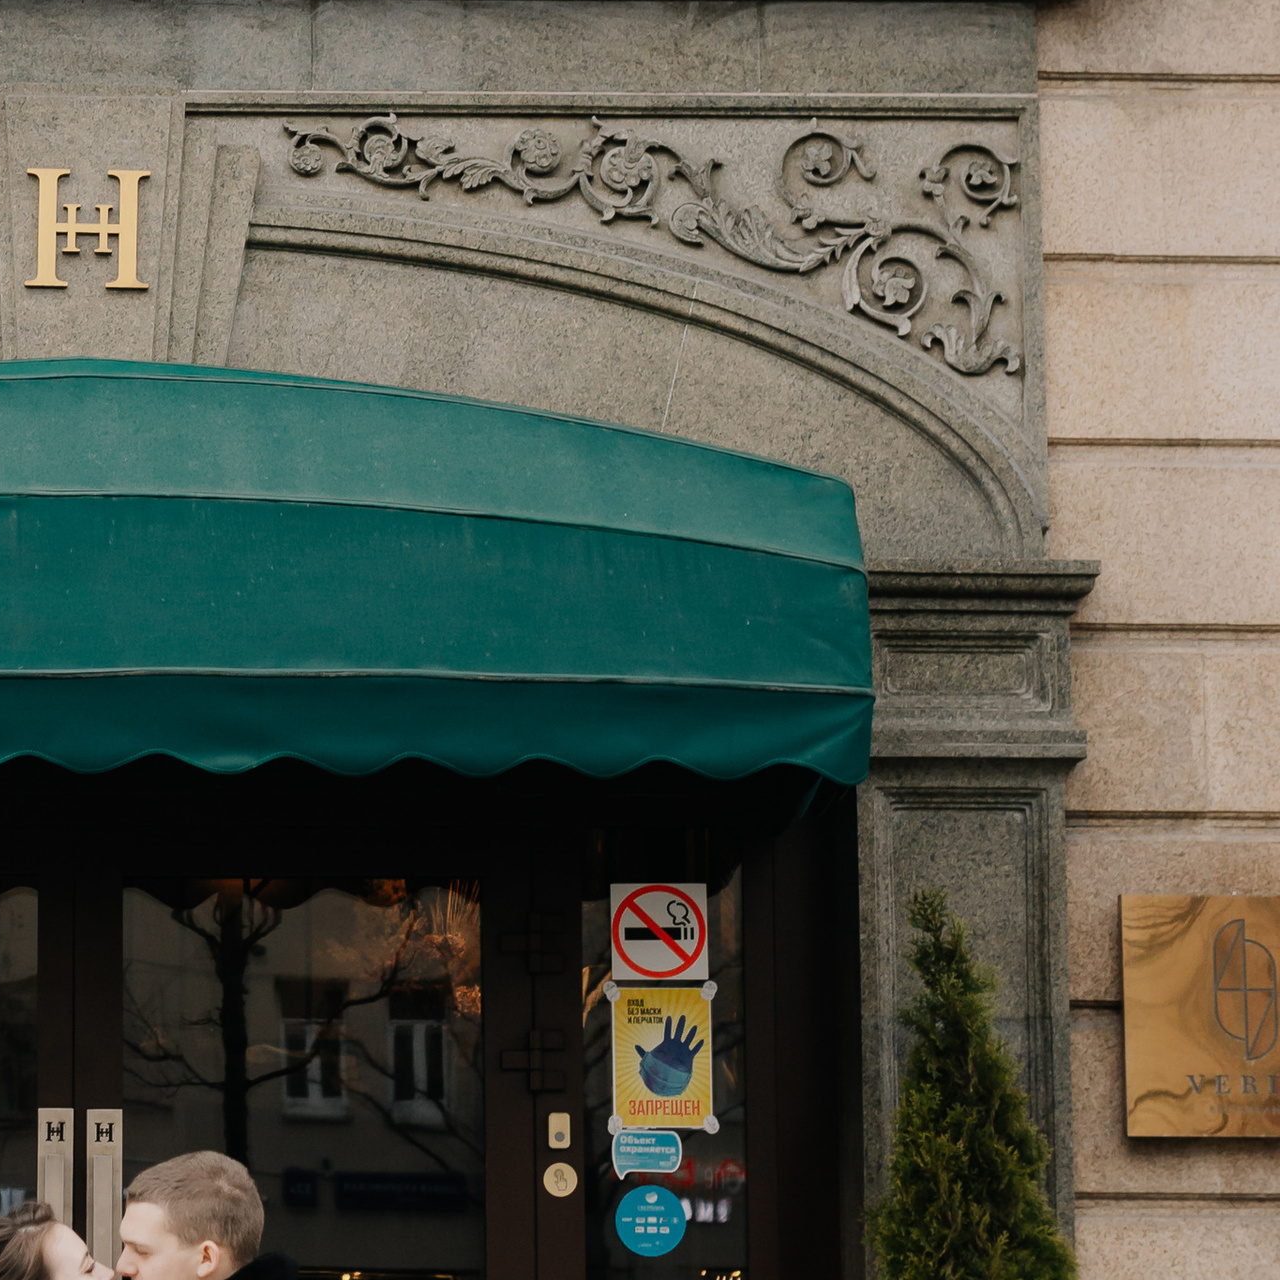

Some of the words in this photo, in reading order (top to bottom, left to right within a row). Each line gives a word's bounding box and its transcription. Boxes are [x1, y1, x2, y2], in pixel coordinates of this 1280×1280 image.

[627, 998, 644, 1007] ВХОД
[627, 1007, 639, 1016] БЕЗ
[640, 1007, 662, 1016] МАСКИ
[633, 1016, 664, 1024] ПЕРЧАТОК
[628, 1099, 701, 1117] ЗАПРЕЩЕН
[619, 1135, 657, 1145] Объект
[619, 1146, 676, 1154] охраняется
